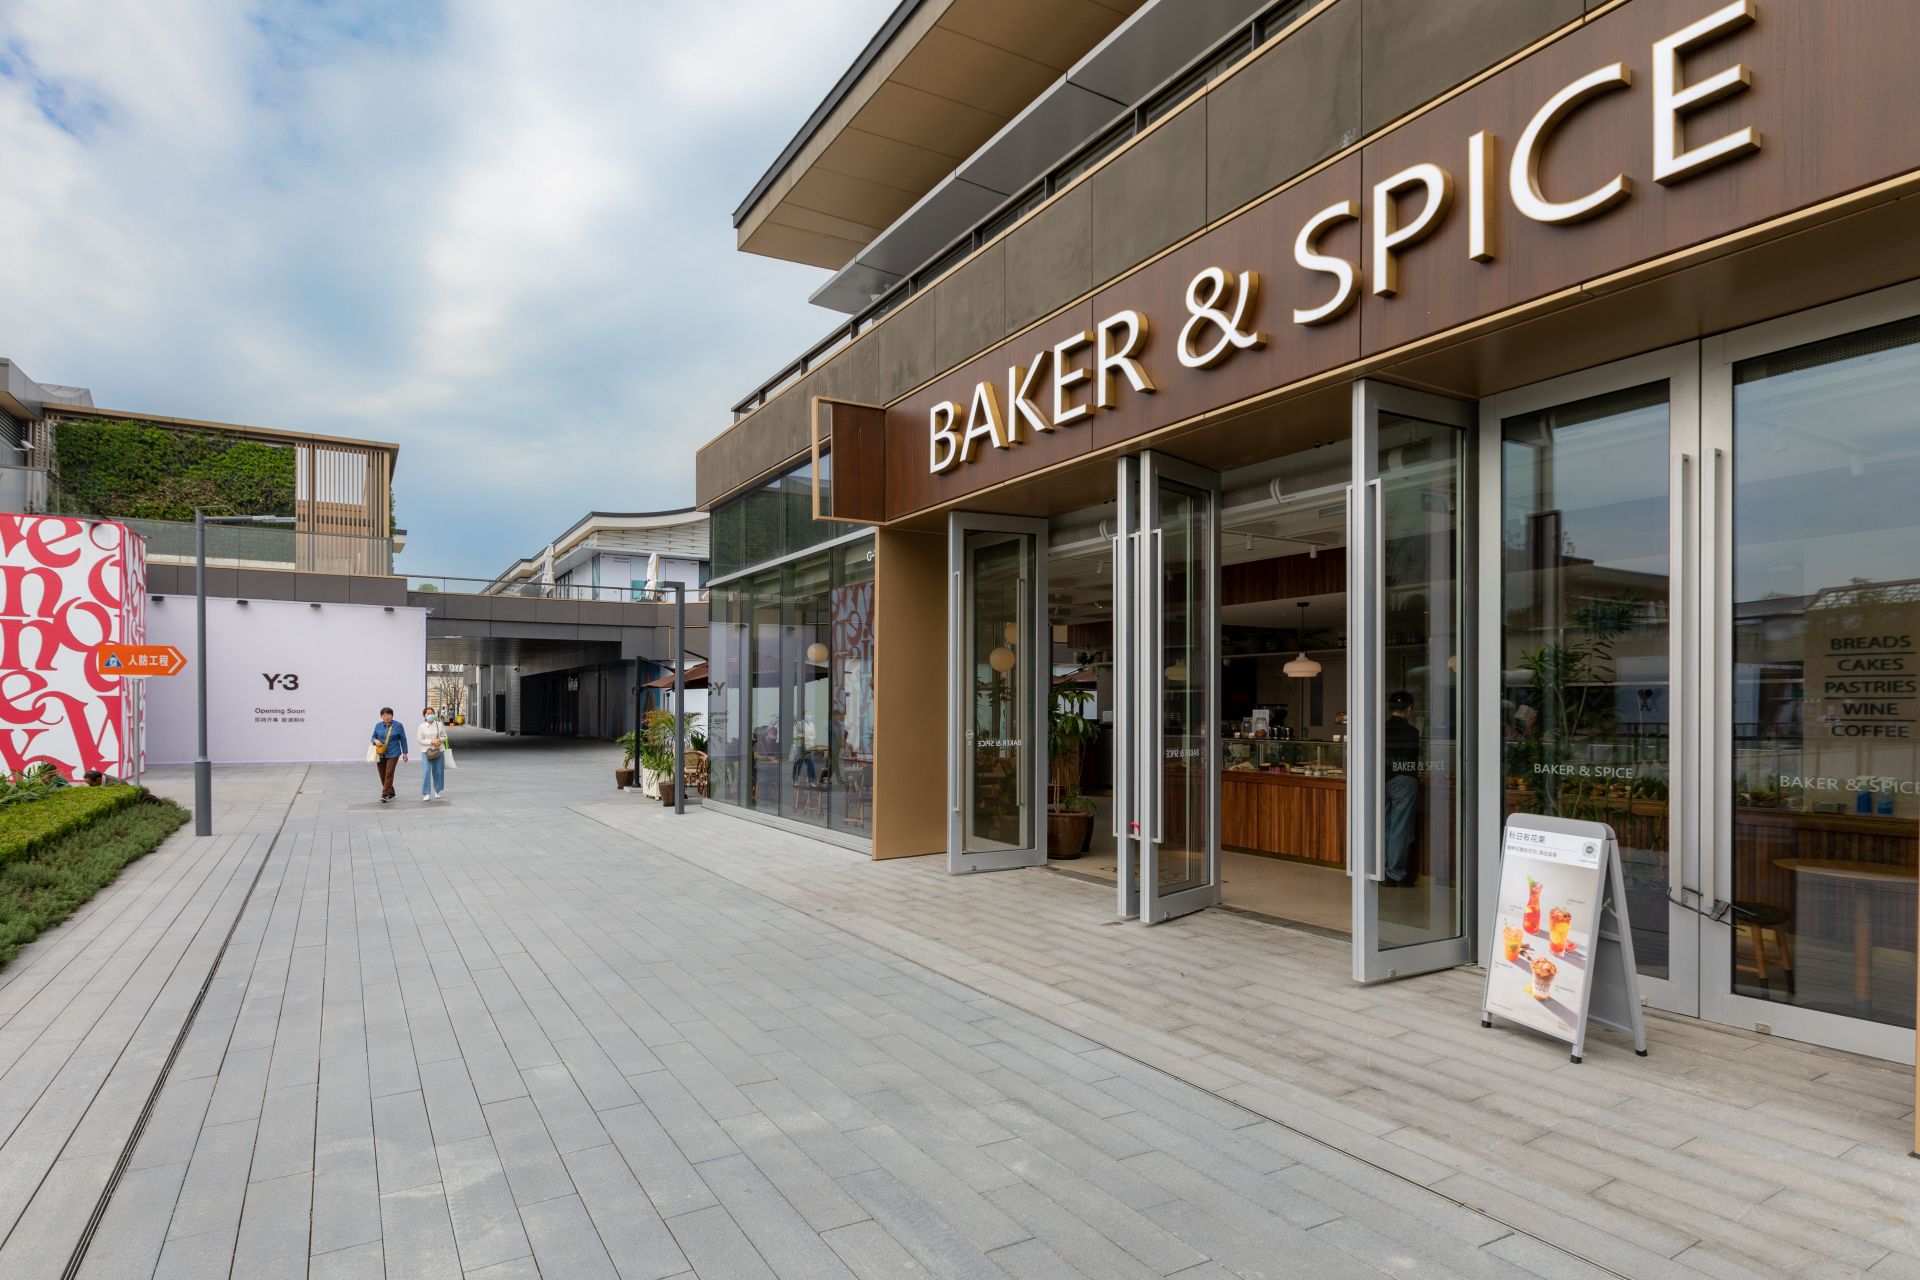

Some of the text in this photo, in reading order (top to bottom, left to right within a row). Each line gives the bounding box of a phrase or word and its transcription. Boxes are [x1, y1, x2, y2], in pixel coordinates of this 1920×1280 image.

[929, 0, 1761, 476] BAKER & SPICE
[1831, 635, 1911, 650] BREADS
[128, 654, 169, 667] 人防工程
[1837, 658, 1904, 671] CAKES
[262, 673, 299, 690] Y-3
[1825, 681, 1916, 693] PASTRIES
[254, 707, 285, 715] Opening
[1842, 703, 1899, 715] WINE
[1831, 725, 1909, 737] COFFEE
[1392, 761, 1416, 771] BAKER
[1534, 763, 1633, 779] BAKER & SPICE
[1780, 775, 1839, 790] BAKER
